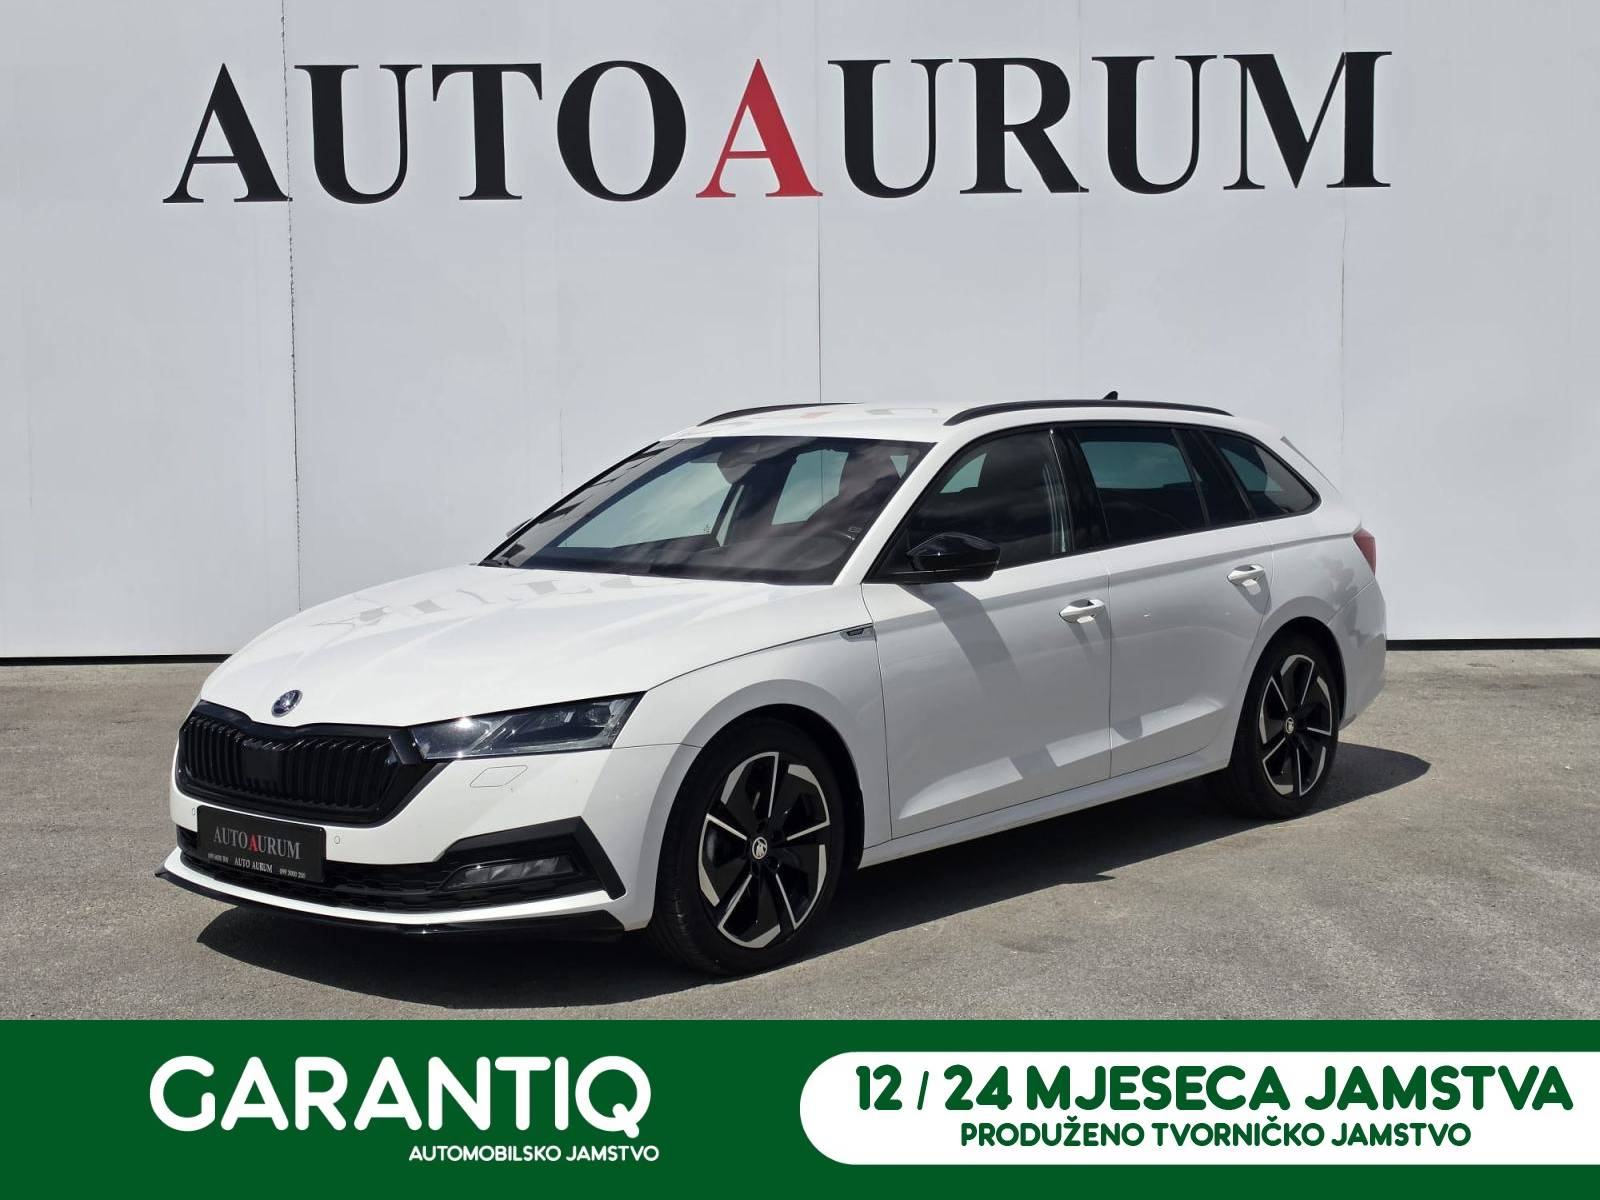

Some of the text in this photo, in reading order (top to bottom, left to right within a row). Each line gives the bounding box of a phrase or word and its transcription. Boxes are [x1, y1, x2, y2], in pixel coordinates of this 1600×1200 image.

[162, 51, 1393, 205] AUTOAURUM
[213, 825, 301, 860] AUTOAURUM
[234, 856, 251, 868] AUTO
[251, 861, 273, 873] AURUM
